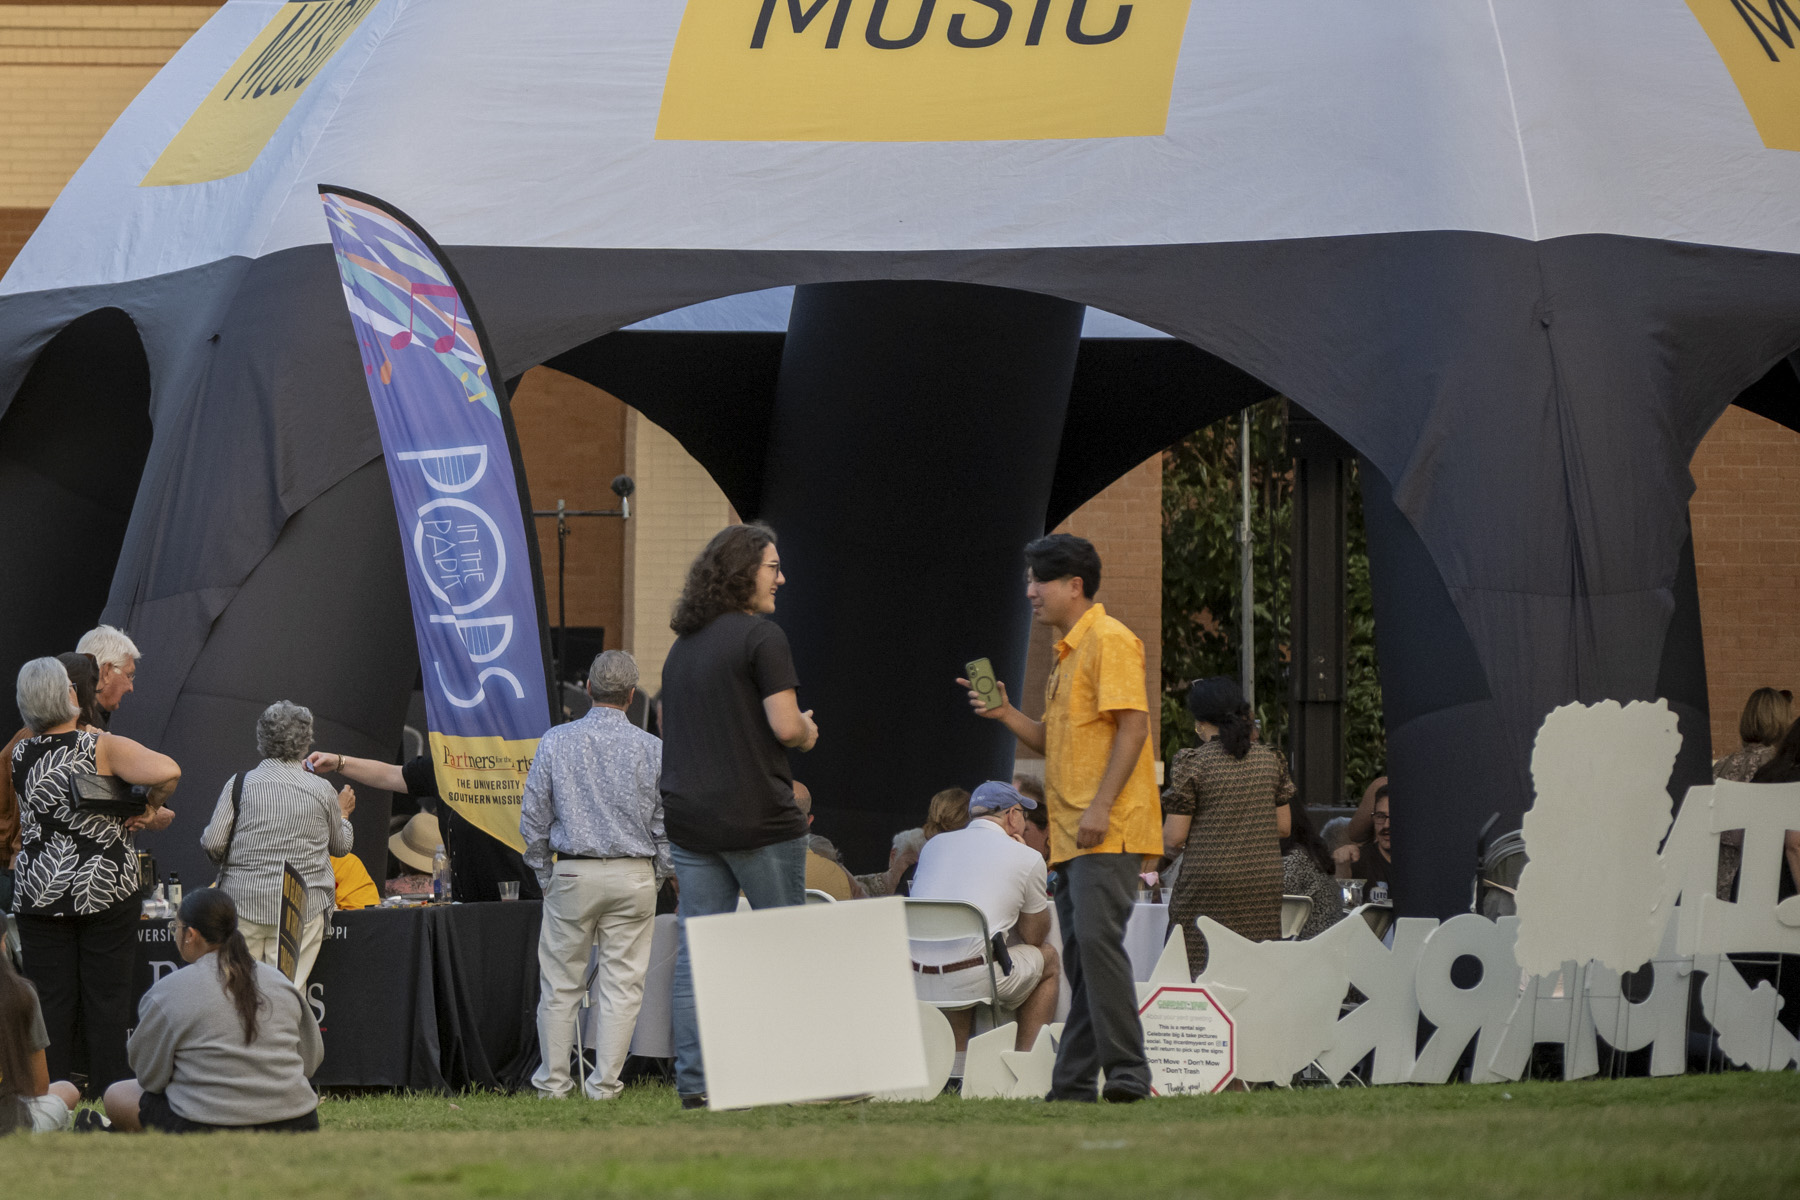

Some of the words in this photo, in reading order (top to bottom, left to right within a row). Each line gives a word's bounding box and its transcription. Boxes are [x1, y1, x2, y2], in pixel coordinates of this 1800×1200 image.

[457, 524, 479, 543] IN
[423, 519, 464, 590] PARK
[461, 550, 485, 584] THE
[397, 444, 525, 708] POPS
[443, 745, 496, 769] Partners
[512, 755, 534, 771] rts
[457, 778, 471, 789] THE
[474, 779, 520, 790] UNIVERSITY
[449, 792, 491, 804] SOUTHERN
